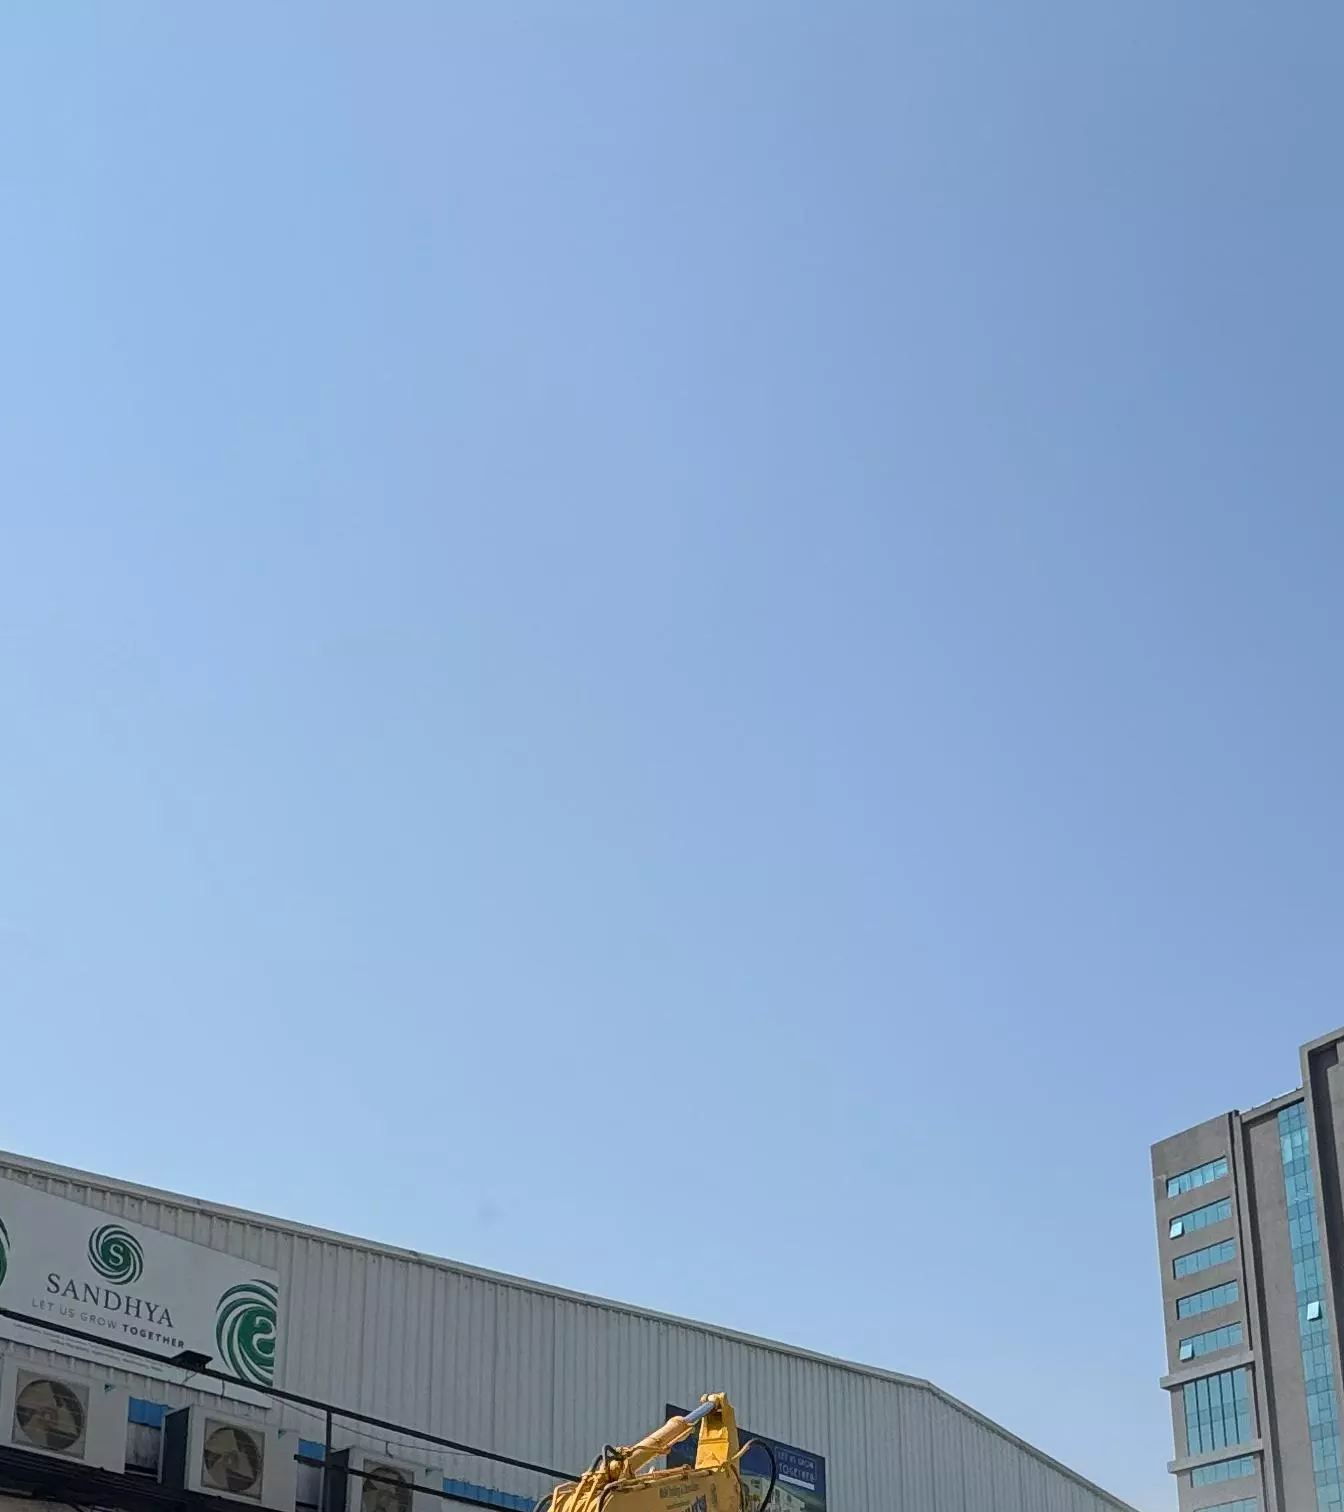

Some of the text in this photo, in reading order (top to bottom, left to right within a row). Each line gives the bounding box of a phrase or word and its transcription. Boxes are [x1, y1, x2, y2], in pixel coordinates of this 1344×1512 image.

[31, 1296, 185, 1349] LET US GROW TOGETHER
[46, 1273, 174, 1328] SANDHYA
